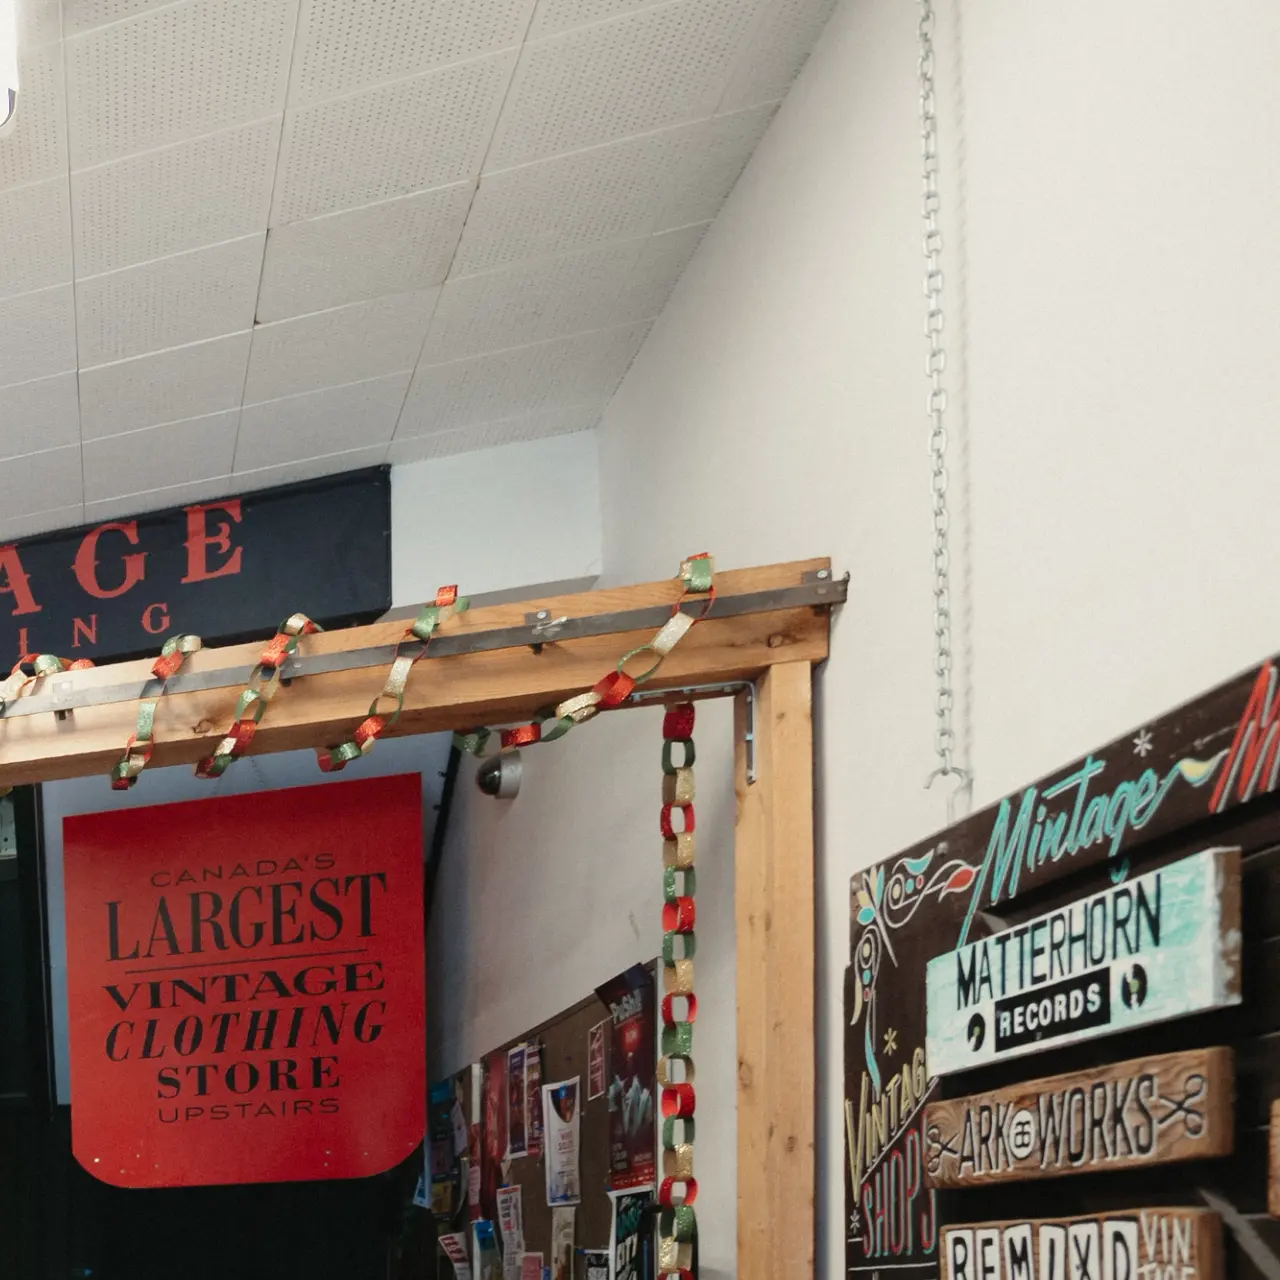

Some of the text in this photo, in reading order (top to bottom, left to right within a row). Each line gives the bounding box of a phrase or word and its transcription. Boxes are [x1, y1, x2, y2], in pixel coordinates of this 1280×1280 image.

[150, 852, 337, 888] CANADA'S
[104, 871, 387, 962] LARGEST
[955, 873, 1162, 1012] MATTERHORN
[101, 960, 386, 1013] VINTAGE
[999, 981, 1102, 1039] RECORDS
[104, 1000, 388, 1063] CLOTHING
[156, 1055, 340, 1100] STORE
[157, 1097, 340, 1124] UPSTAIRS
[844, 1046, 927, 1208] VINTAG
[1039, 1073, 1159, 1171] WORKS
[1140, 1213, 1192, 1264] VIN
